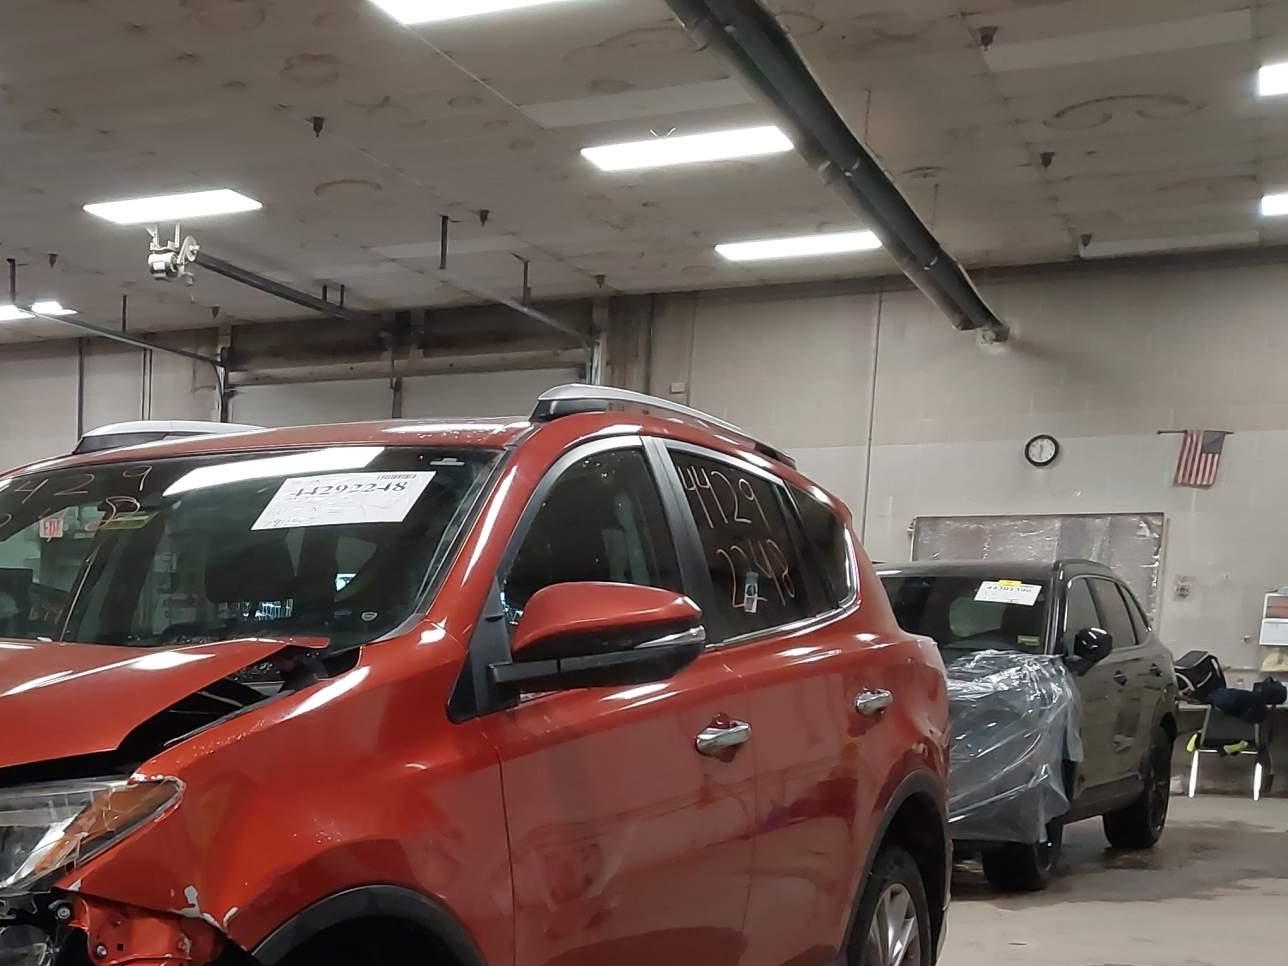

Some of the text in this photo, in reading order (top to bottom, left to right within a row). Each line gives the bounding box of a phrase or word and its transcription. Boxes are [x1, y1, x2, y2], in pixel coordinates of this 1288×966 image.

[289, 481, 409, 497] 44292248
[677, 464, 772, 530] 4429
[716, 538, 795, 608] 2248
